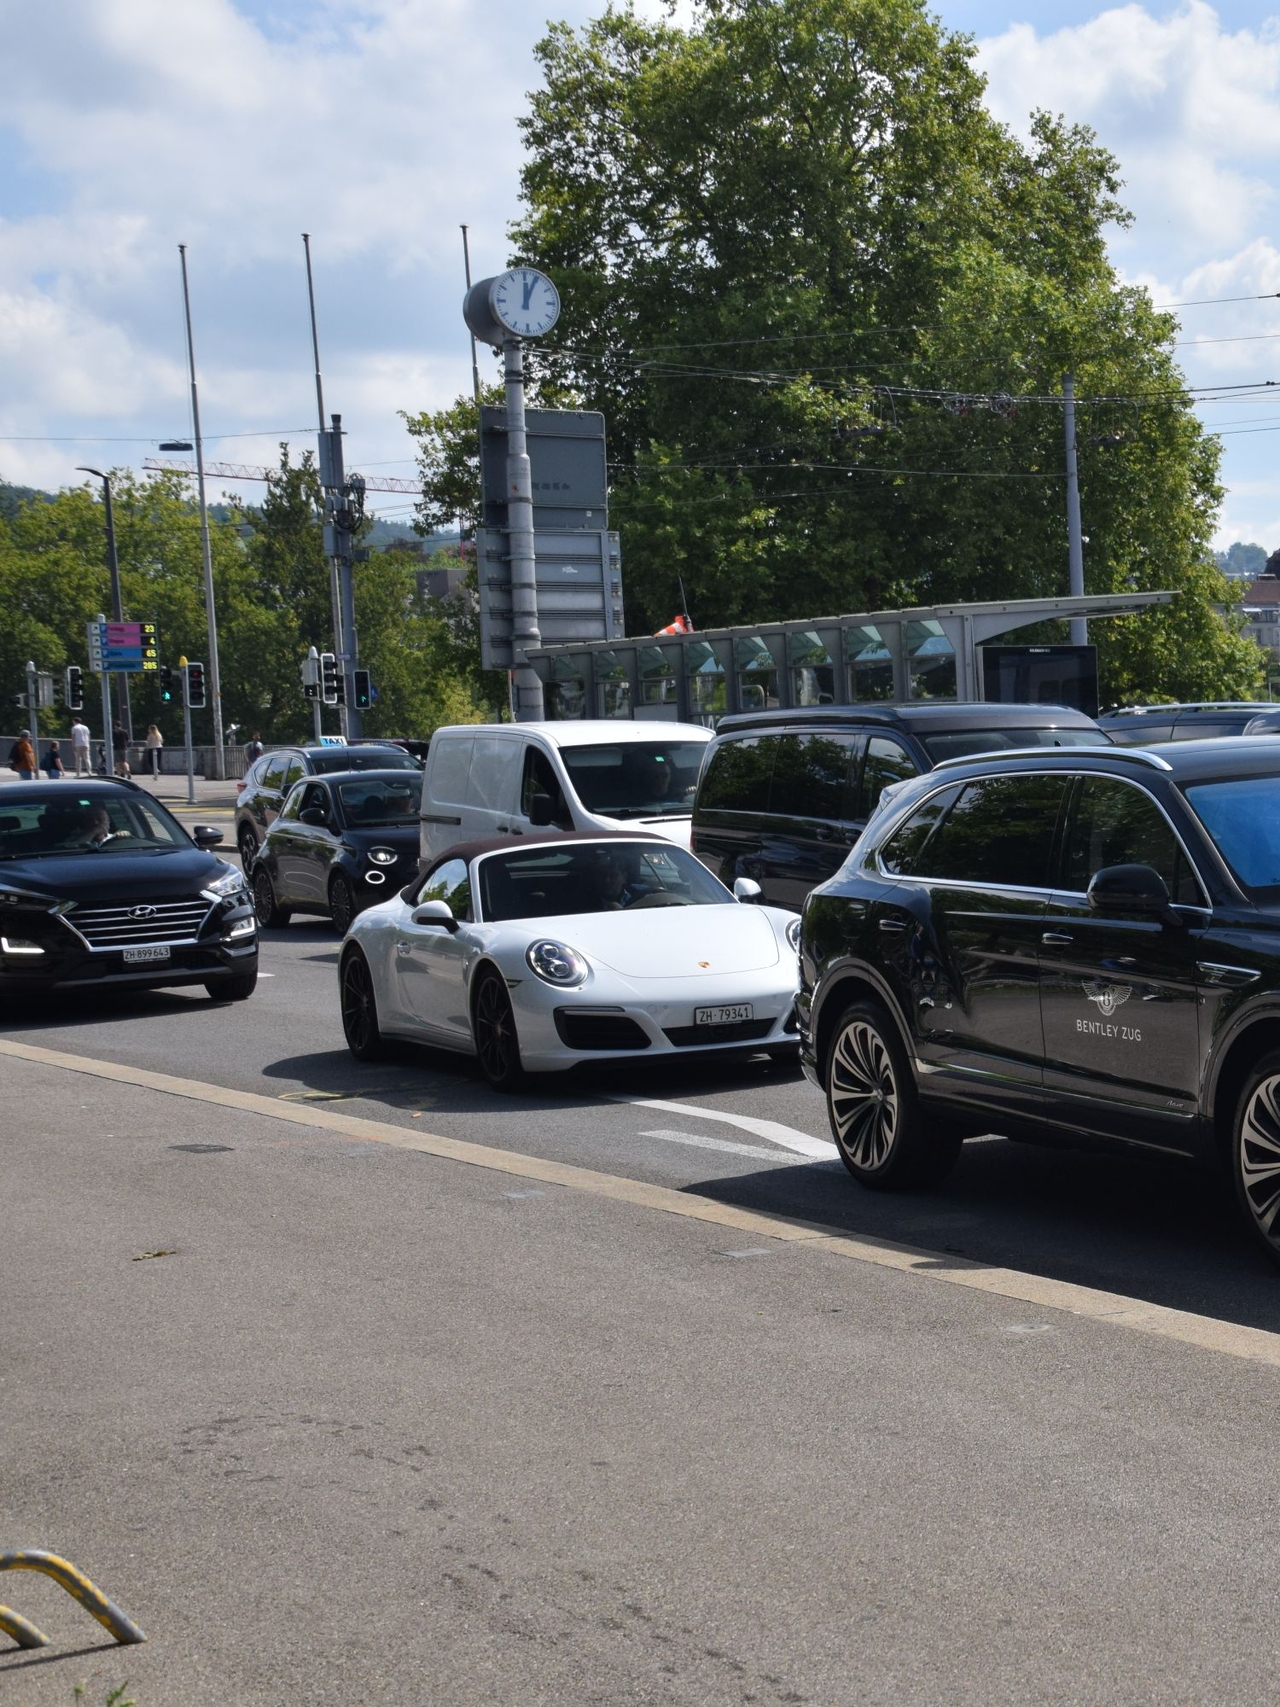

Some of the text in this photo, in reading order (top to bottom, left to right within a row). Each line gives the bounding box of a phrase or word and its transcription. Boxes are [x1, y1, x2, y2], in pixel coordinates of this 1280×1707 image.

[144, 624, 155, 633] 23
[322, 737, 345, 745] TAXI
[1076, 1019, 1142, 1042] BENTLEY ZUG
